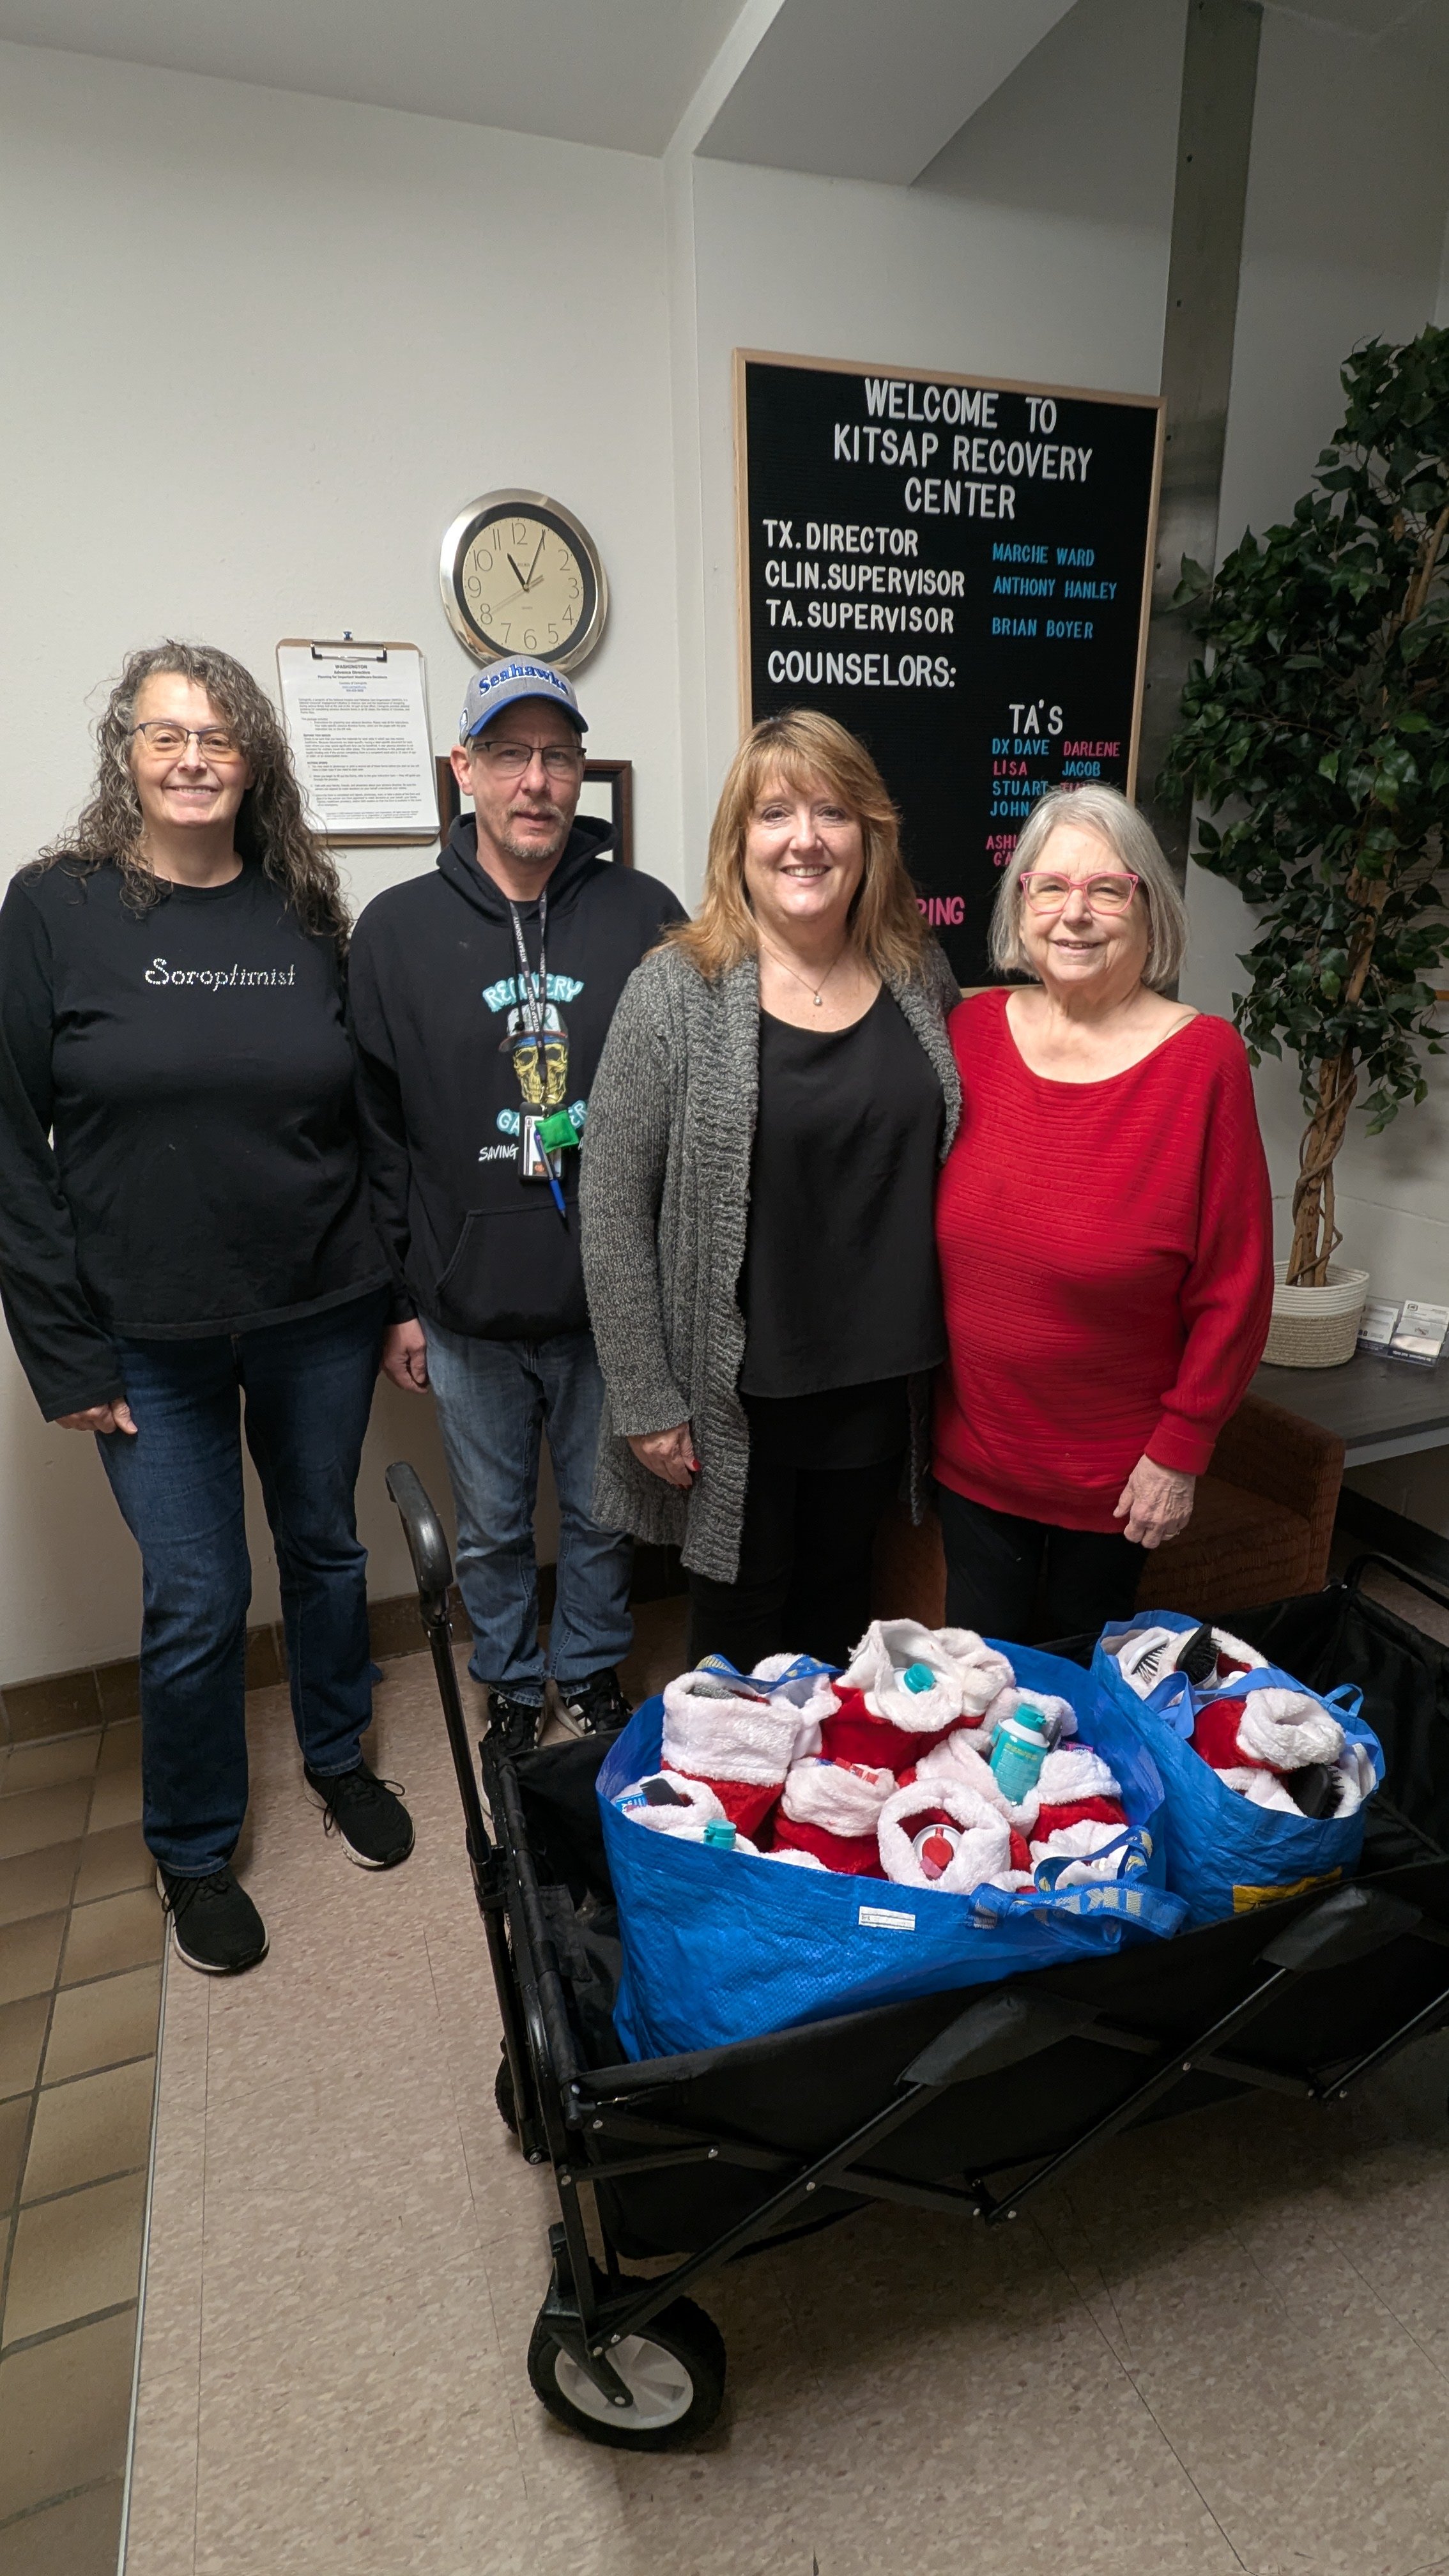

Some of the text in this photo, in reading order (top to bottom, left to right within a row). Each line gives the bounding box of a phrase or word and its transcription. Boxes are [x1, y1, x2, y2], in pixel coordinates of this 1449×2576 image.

[864, 378, 1057, 435] WELCOME TO
[834, 423, 1093, 483] KITSAP RECOVERY
[905, 476, 1016, 520] CENTER
[493, 528, 501, 551] 11
[512, 522, 528, 545] 12
[473, 549, 493, 572] 10
[557, 549, 571, 571] 2
[1056, 547, 1096, 567] WARD
[468, 576, 482, 599] 9
[567, 577, 579, 599] 3
[993, 576, 1118, 601] ANTHONY HANLEY
[480, 602, 493, 625] 8
[562, 604, 574, 625] 4
[500, 622, 512, 644] 7
[523, 629, 537, 650] 6
[548, 623, 559, 645] 5
[992, 617, 1094, 640] BRIAN BOYER
[479, 663, 569, 697] Seahawks
[768, 650, 957, 688] COUNSELORS:
[1008, 698, 1064, 735] TA'S
[992, 737, 1050, 756] DX DAVE
[1063, 740, 1121, 757] DARLENE
[993, 759, 1028, 776] LISA
[1061, 760, 1101, 777] JACOB
[992, 780, 1048, 796] STUART
[990, 801, 1030, 816] JOHN
[513, 916, 523, 940] COUNTY
[144, 958, 296, 992] Soroptimist
[526, 986, 536, 1011] COUNTY
[479, 1143, 519, 1162] SAVING
